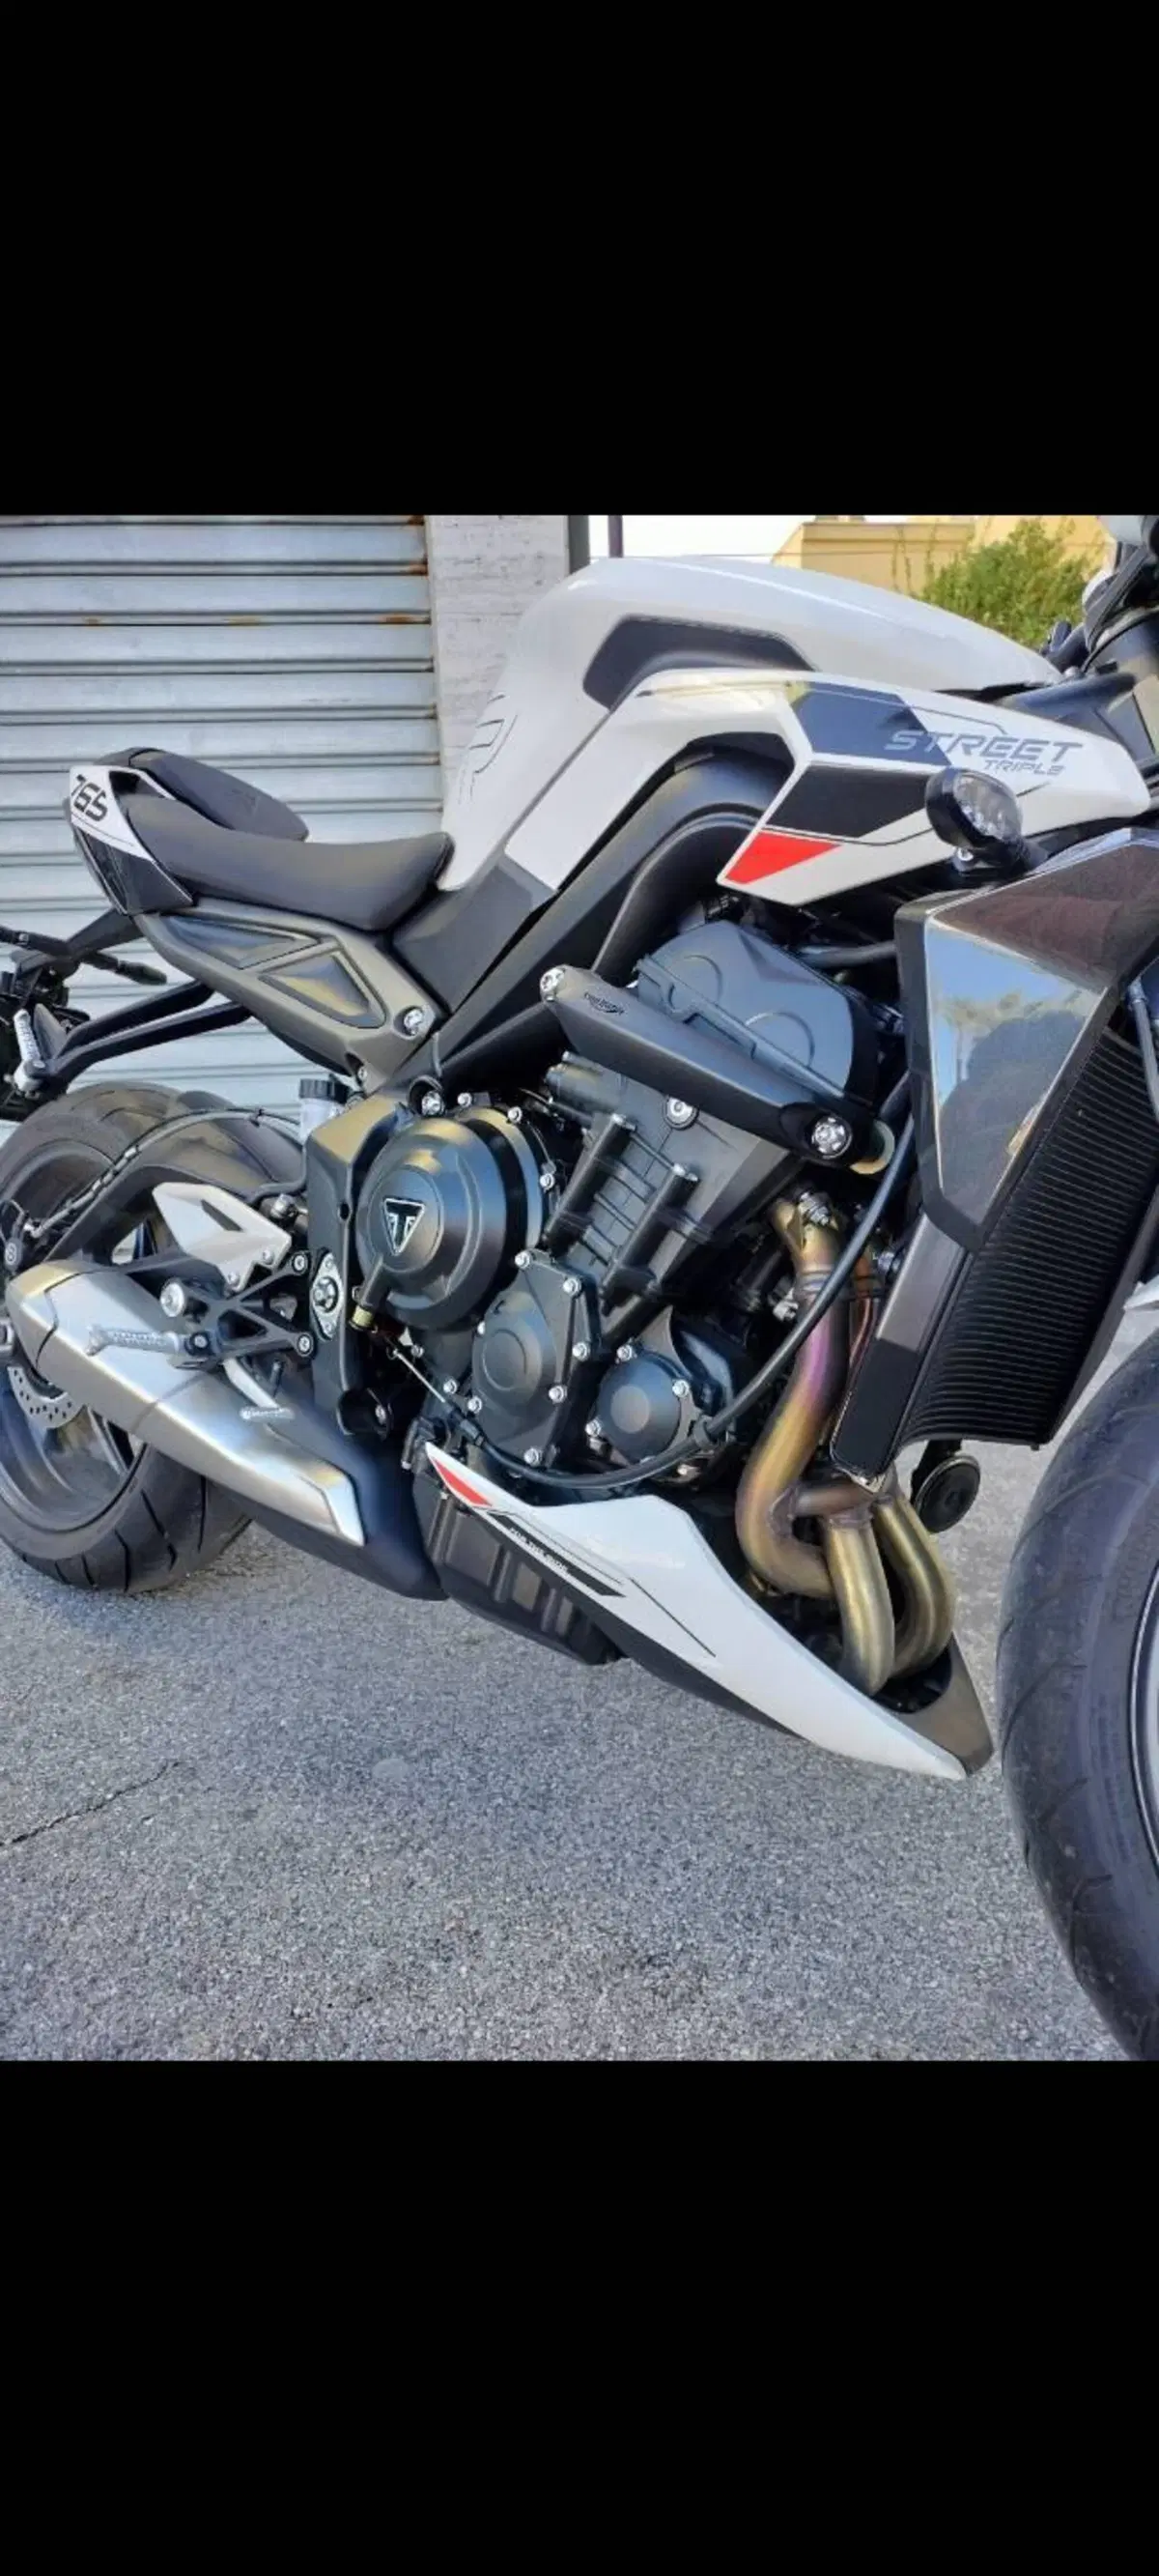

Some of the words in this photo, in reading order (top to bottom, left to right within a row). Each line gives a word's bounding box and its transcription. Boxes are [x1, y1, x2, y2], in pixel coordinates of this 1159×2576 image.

[884, 730, 1084, 761] STREET
[983, 758, 1064, 776] TRIPLE
[71, 774, 107, 821] 765
